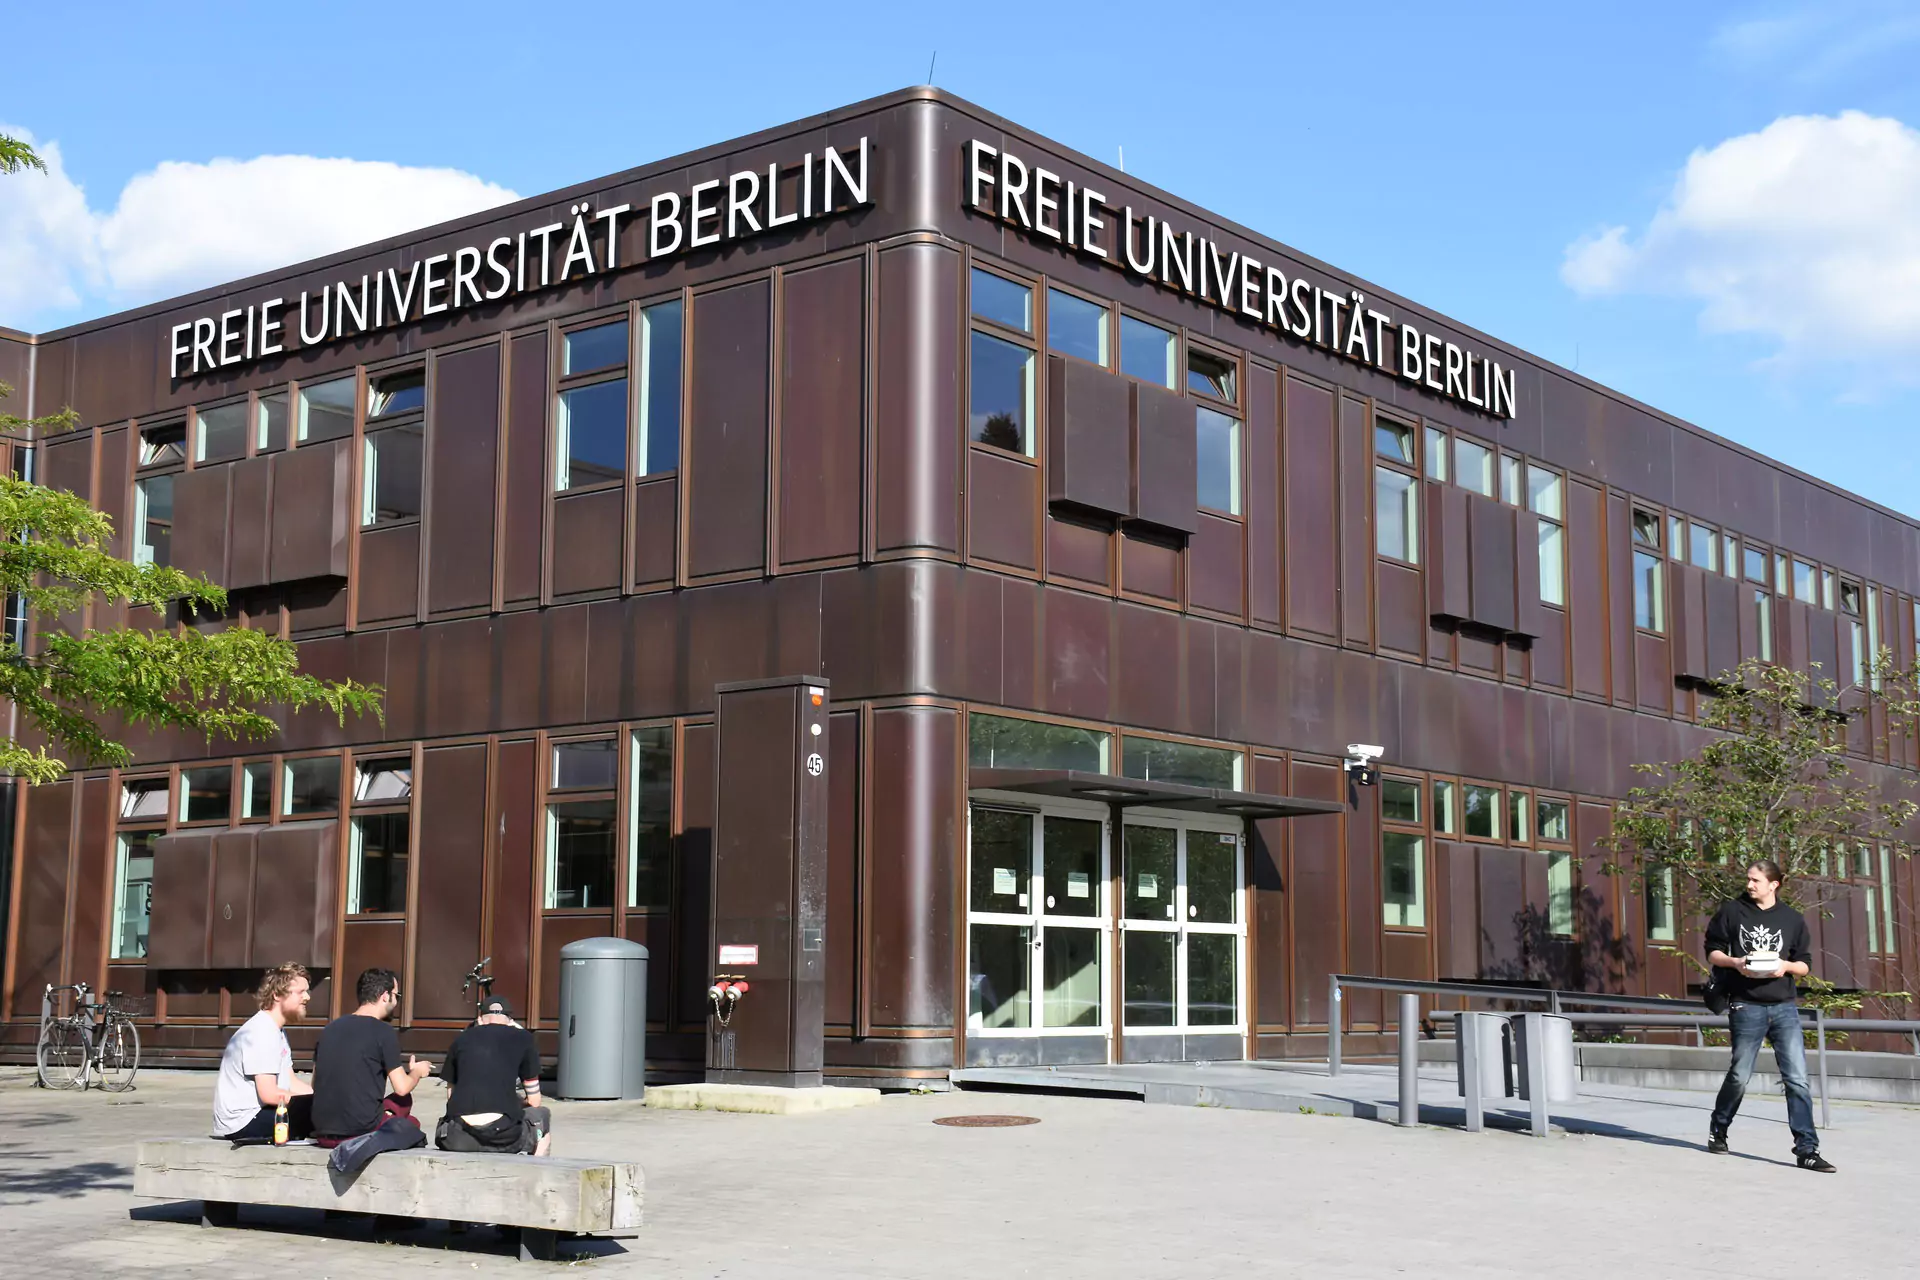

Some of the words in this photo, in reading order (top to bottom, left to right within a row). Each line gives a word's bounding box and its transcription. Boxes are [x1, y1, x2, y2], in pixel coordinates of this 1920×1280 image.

[171, 298, 283, 379] FREIE
[300, 203, 630, 345] UNIVERSITÄT
[650, 136, 868, 258] BERLIN
[971, 138, 1108, 258] FREIE
[1125, 205, 1391, 367] UNIVERSITÄT
[1402, 323, 1516, 419] BERLIN
[808, 757, 821, 773] 45
